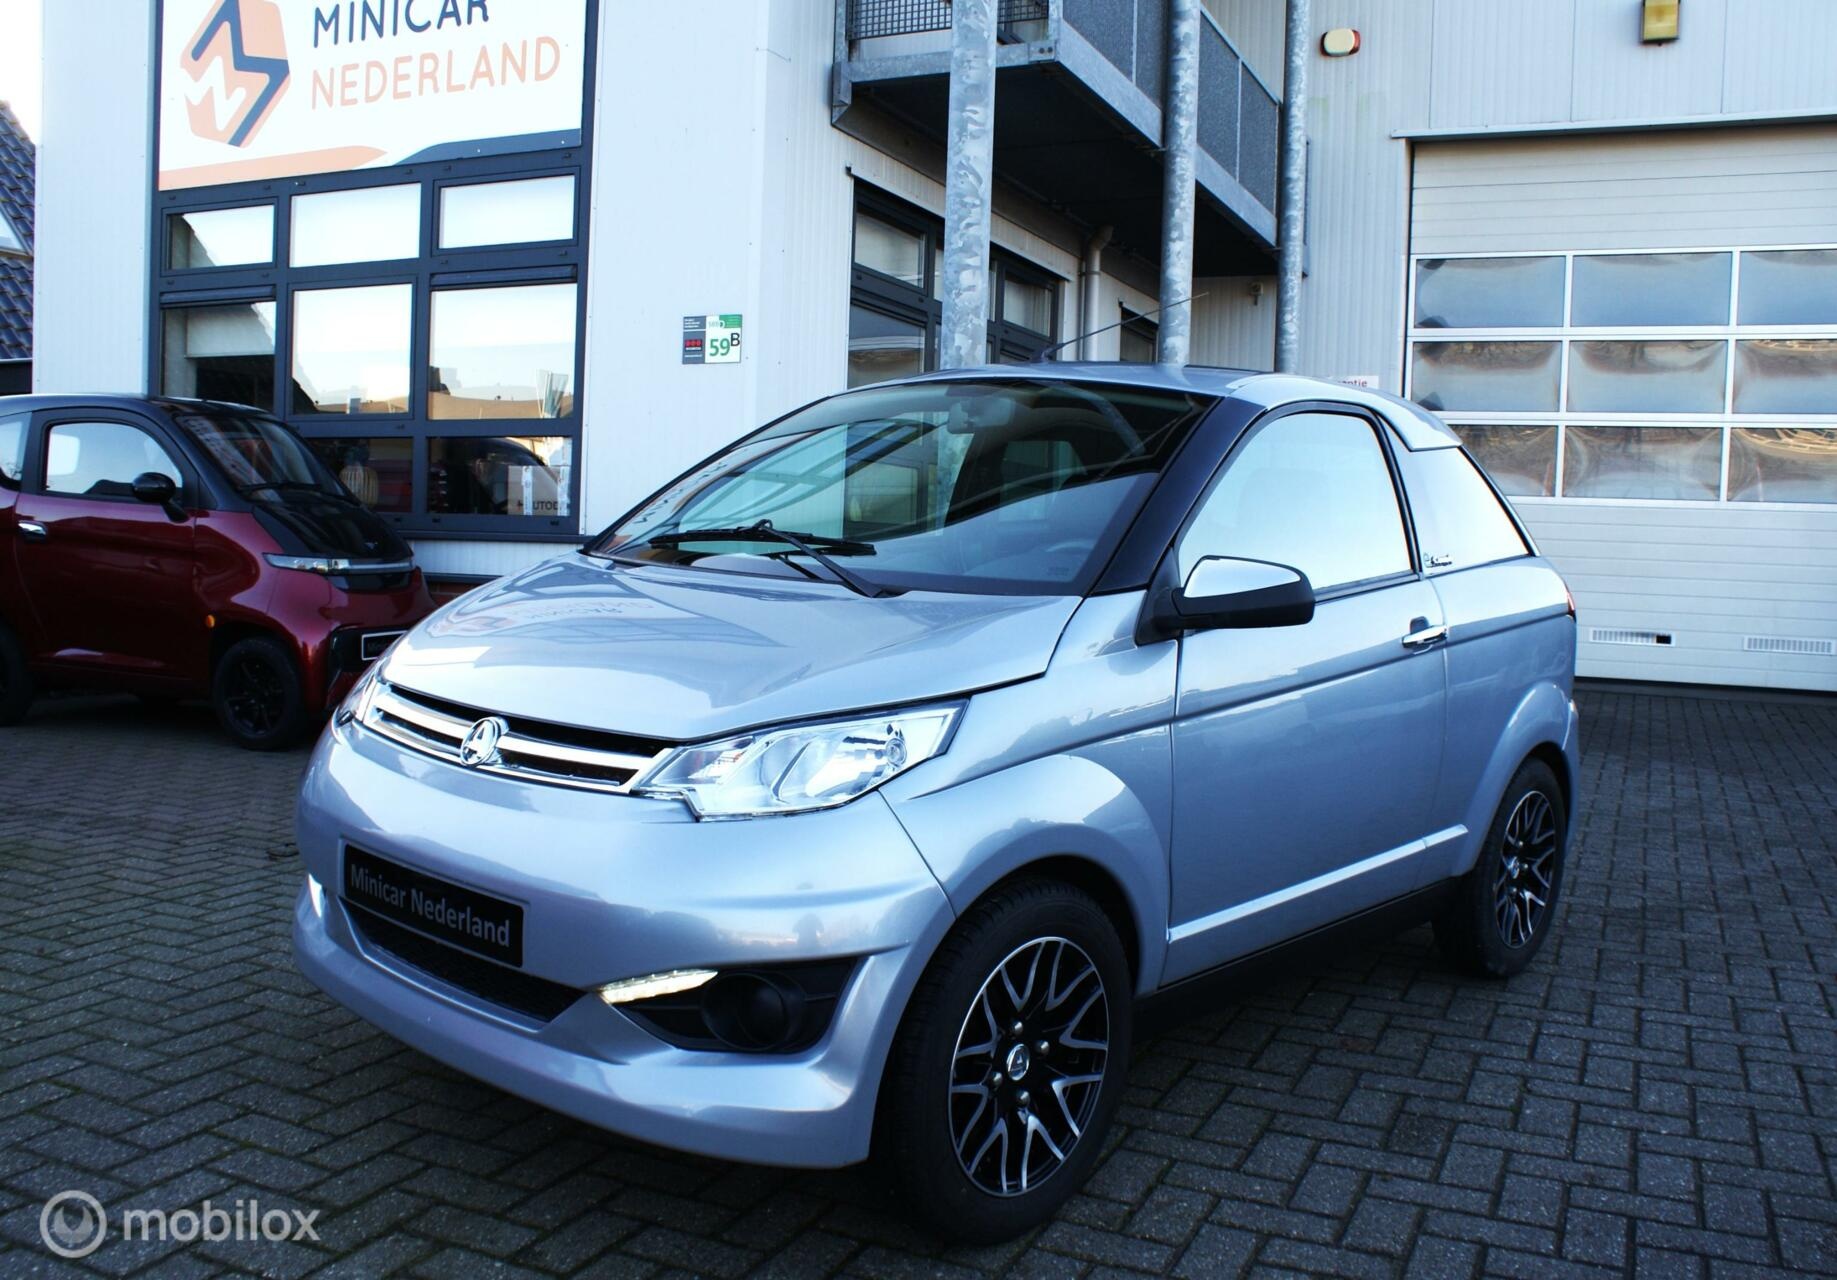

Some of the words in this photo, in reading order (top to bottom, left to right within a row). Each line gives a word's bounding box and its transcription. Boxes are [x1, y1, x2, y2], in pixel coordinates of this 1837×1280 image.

[314, 0, 489, 48] MINICAR
[311, 36, 561, 110] NEDERLAND
[351, 864, 406, 908] Minicar
[411, 888, 510, 947] Nederland
